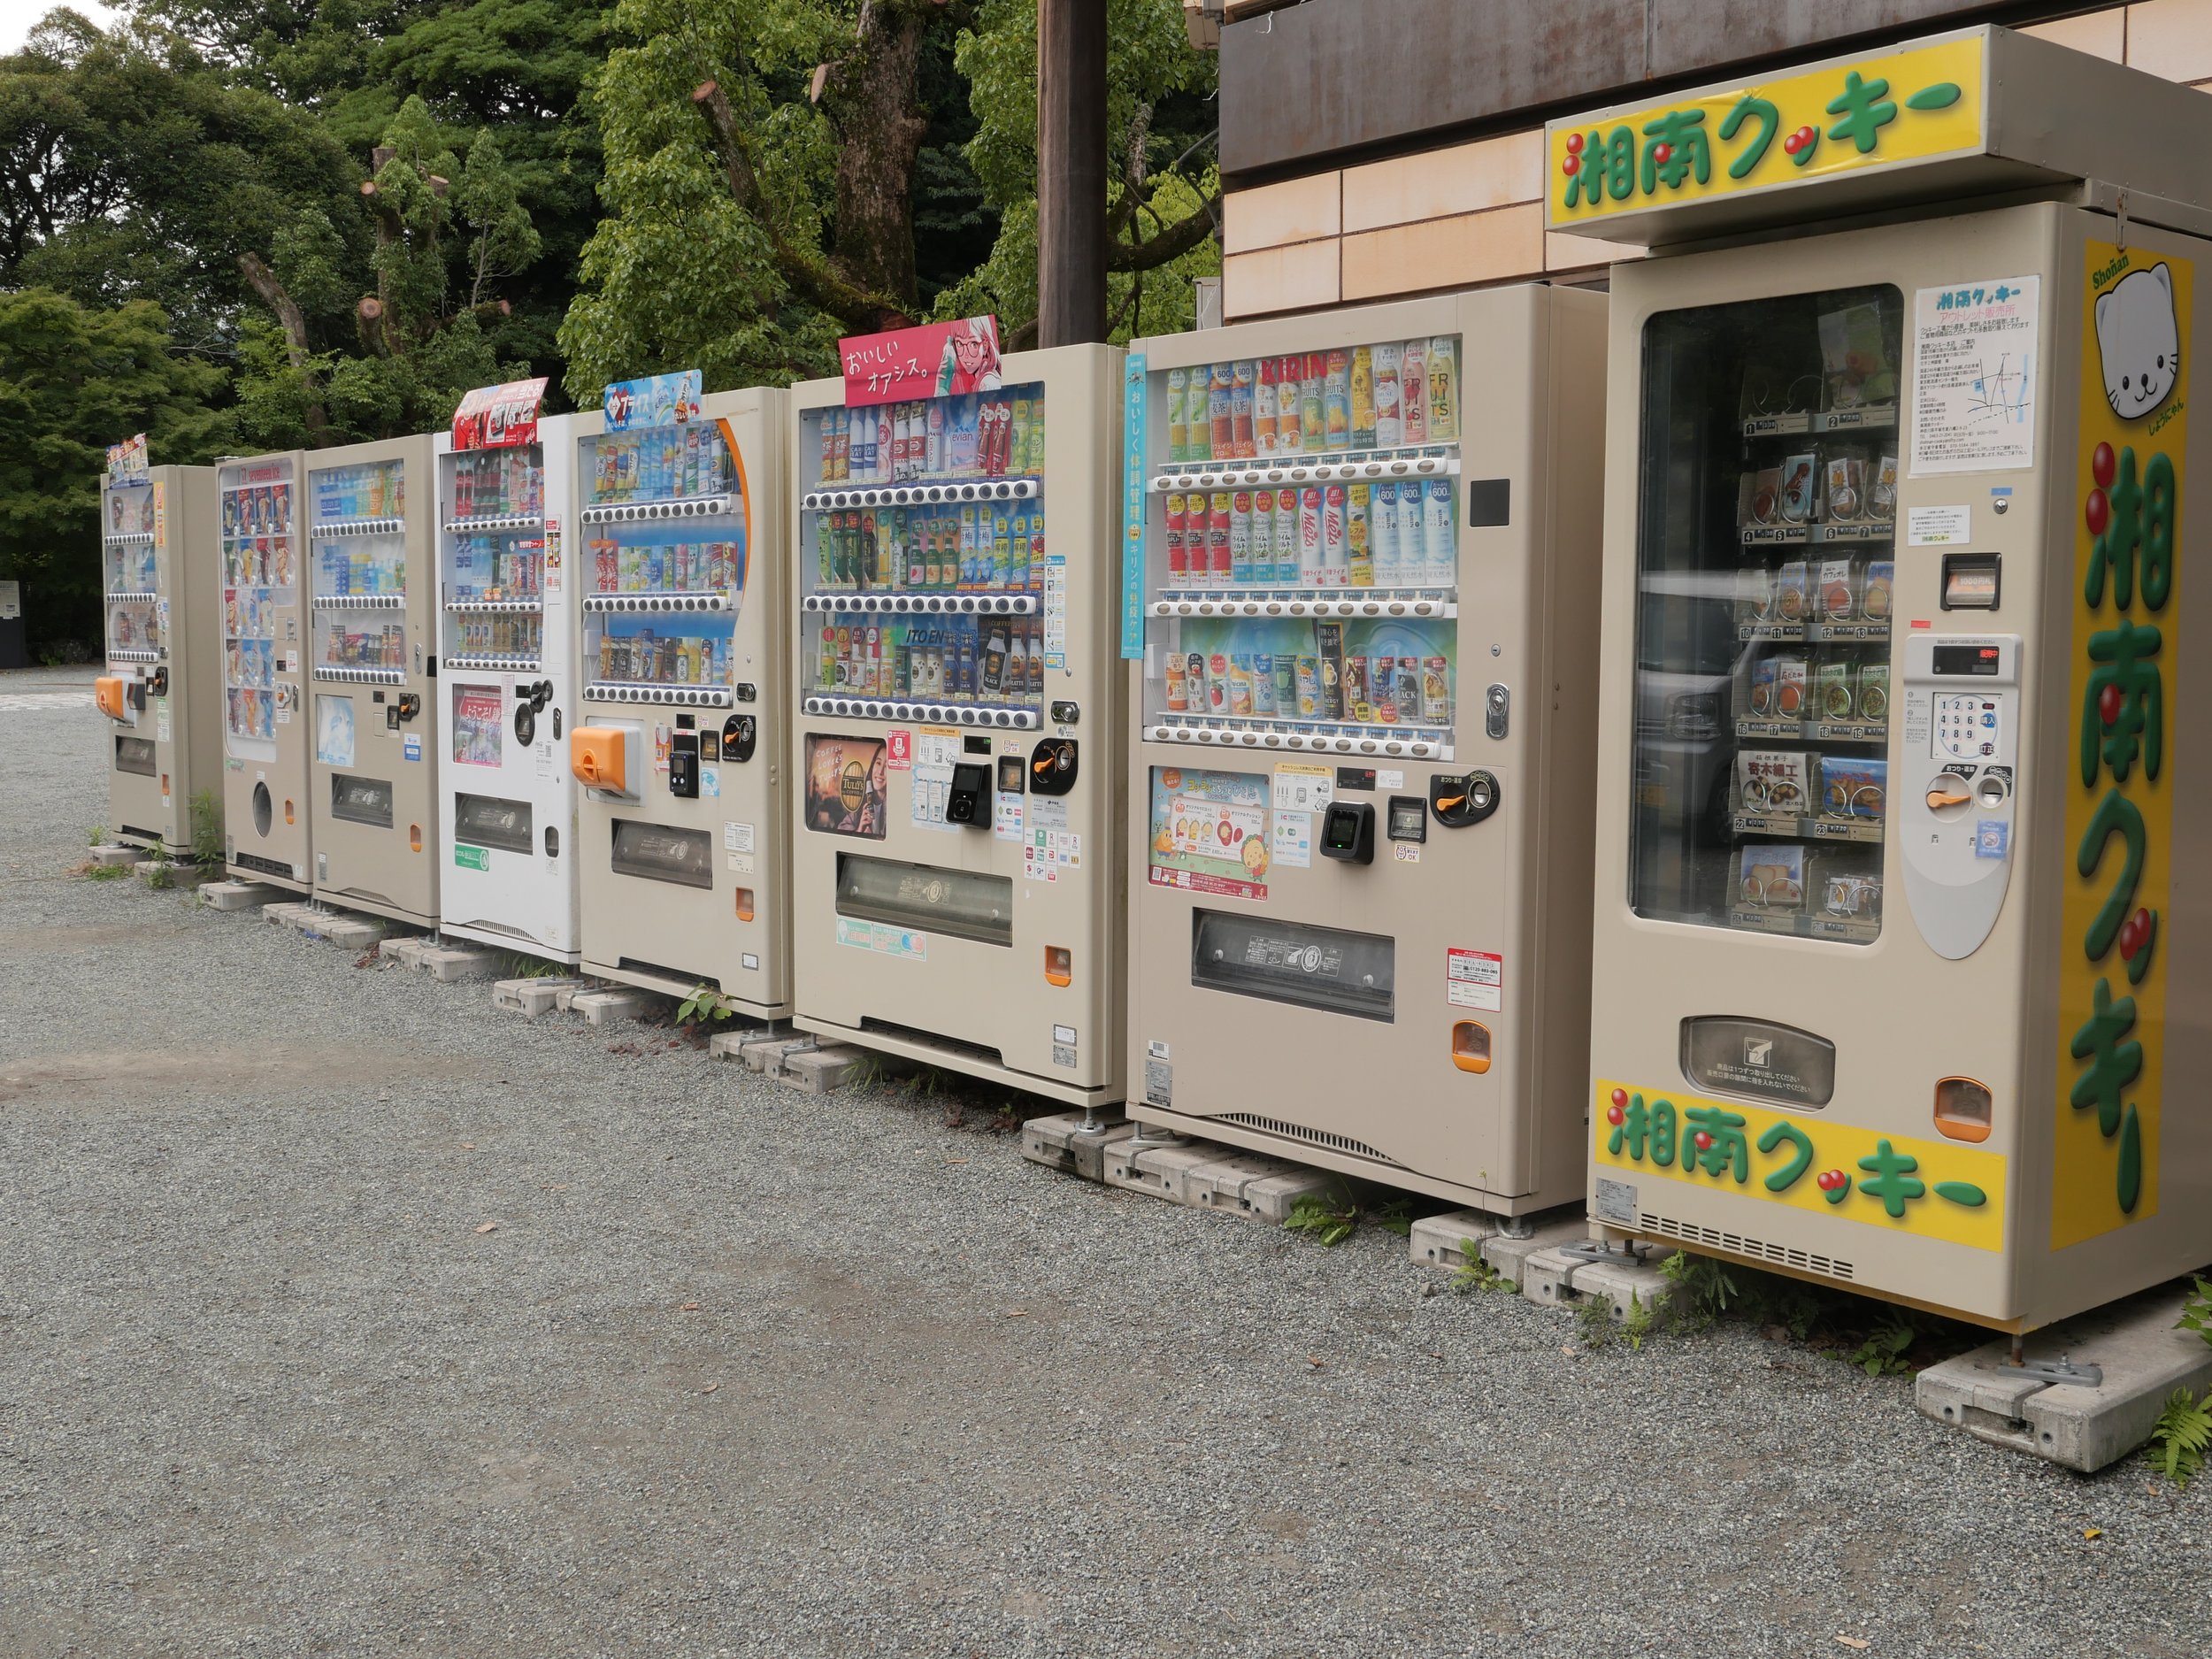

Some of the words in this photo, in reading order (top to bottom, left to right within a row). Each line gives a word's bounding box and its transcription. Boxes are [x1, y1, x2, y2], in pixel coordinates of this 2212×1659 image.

[1563, 70, 1962, 209] 湘南クッキー
[1936, 285, 2021, 311] 湘南クッキー
[1939, 304, 2016, 324] アウトレット販売所
[846, 341, 899, 376] おいしい
[867, 357, 927, 396] オアシス。
[1262, 354, 1327, 385] KIRIN
[620, 394, 650, 417] プライス
[2148, 397, 2185, 436] しょうにゃん
[1381, 491, 1394, 500] 600
[1403, 489, 1417, 498] 600
[1432, 488, 1447, 497] 600
[1302, 512, 1319, 547] Mets
[1325, 510, 1342, 545] Mets
[1823, 571, 1847, 580] カフェオレ
[906, 629, 927, 643] ITO
[929, 629, 944, 644] EN
[985, 676, 998, 685] BLACK
[1739, 725, 1747, 733] 16
[1770, 726, 1778, 735] 17
[1820, 727, 1829, 736] 18
[1747, 762, 1797, 778] 寄木細工
[1816, 826, 1825, 835] 23
[2070, 441, 2175, 1214] 湘南クッキー
[1607, 1088, 1986, 1217] 湘南クッキー
